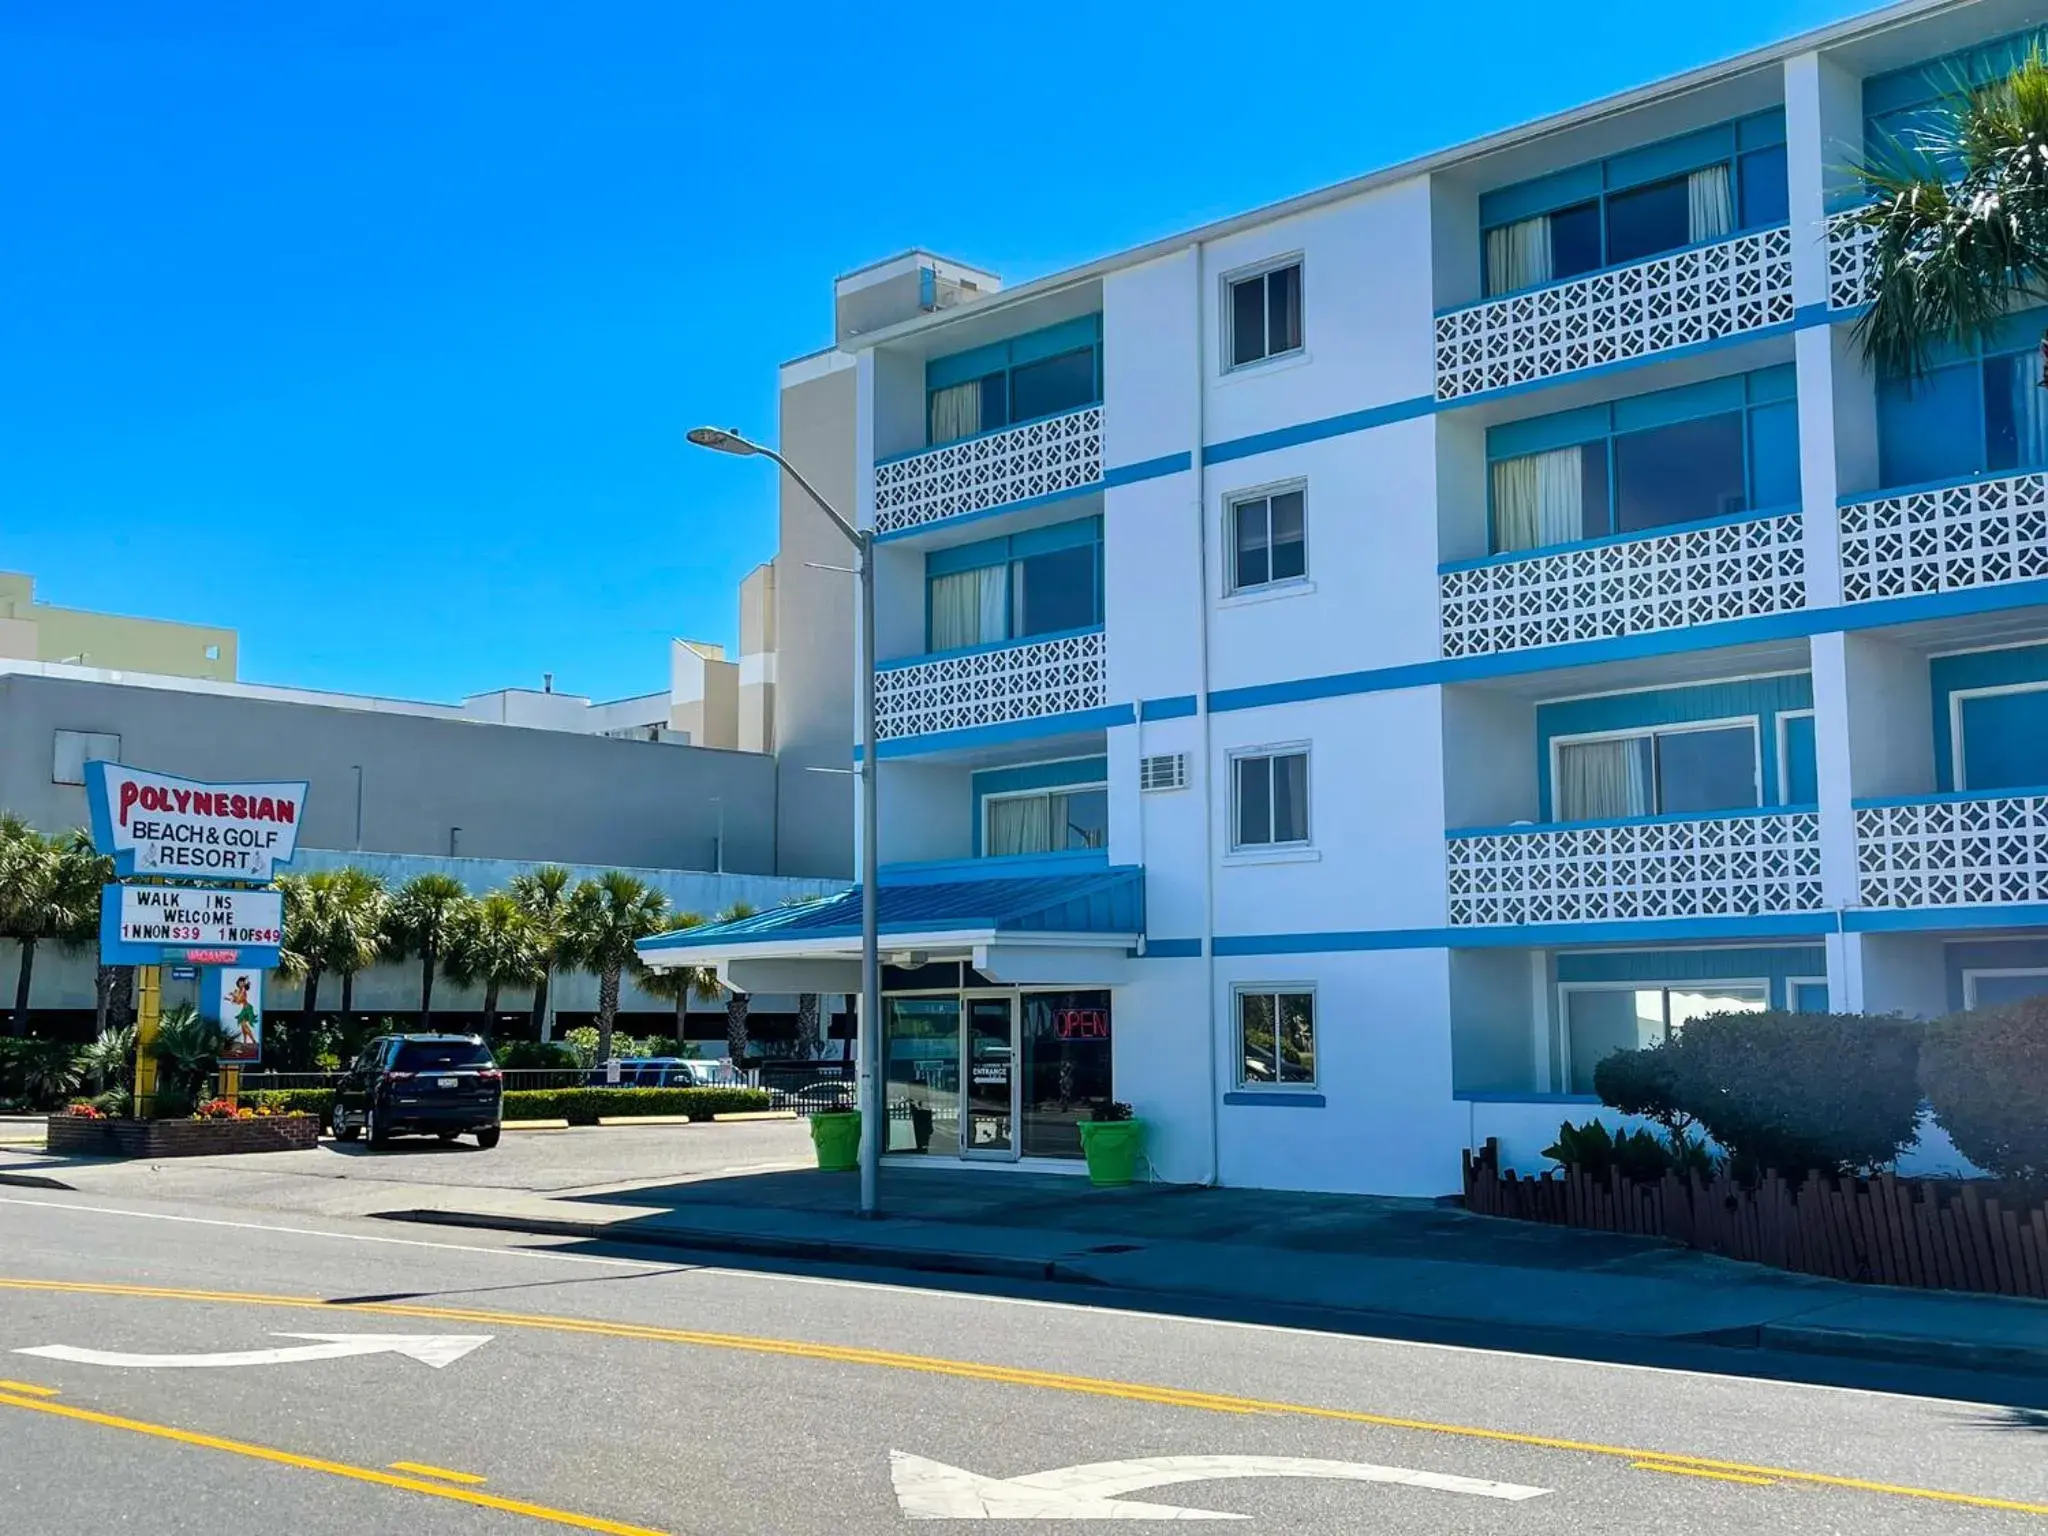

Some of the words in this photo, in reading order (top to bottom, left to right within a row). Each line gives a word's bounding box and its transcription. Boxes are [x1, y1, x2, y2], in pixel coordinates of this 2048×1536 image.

[119, 781, 295, 827] POLYNESIAN
[223, 828, 278, 849] GOLF
[160, 846, 250, 870] RESORT
[137, 891, 180, 907] WALK
[164, 909, 234, 925] WELCOME
[1056, 1011, 1107, 1038] OPEN
